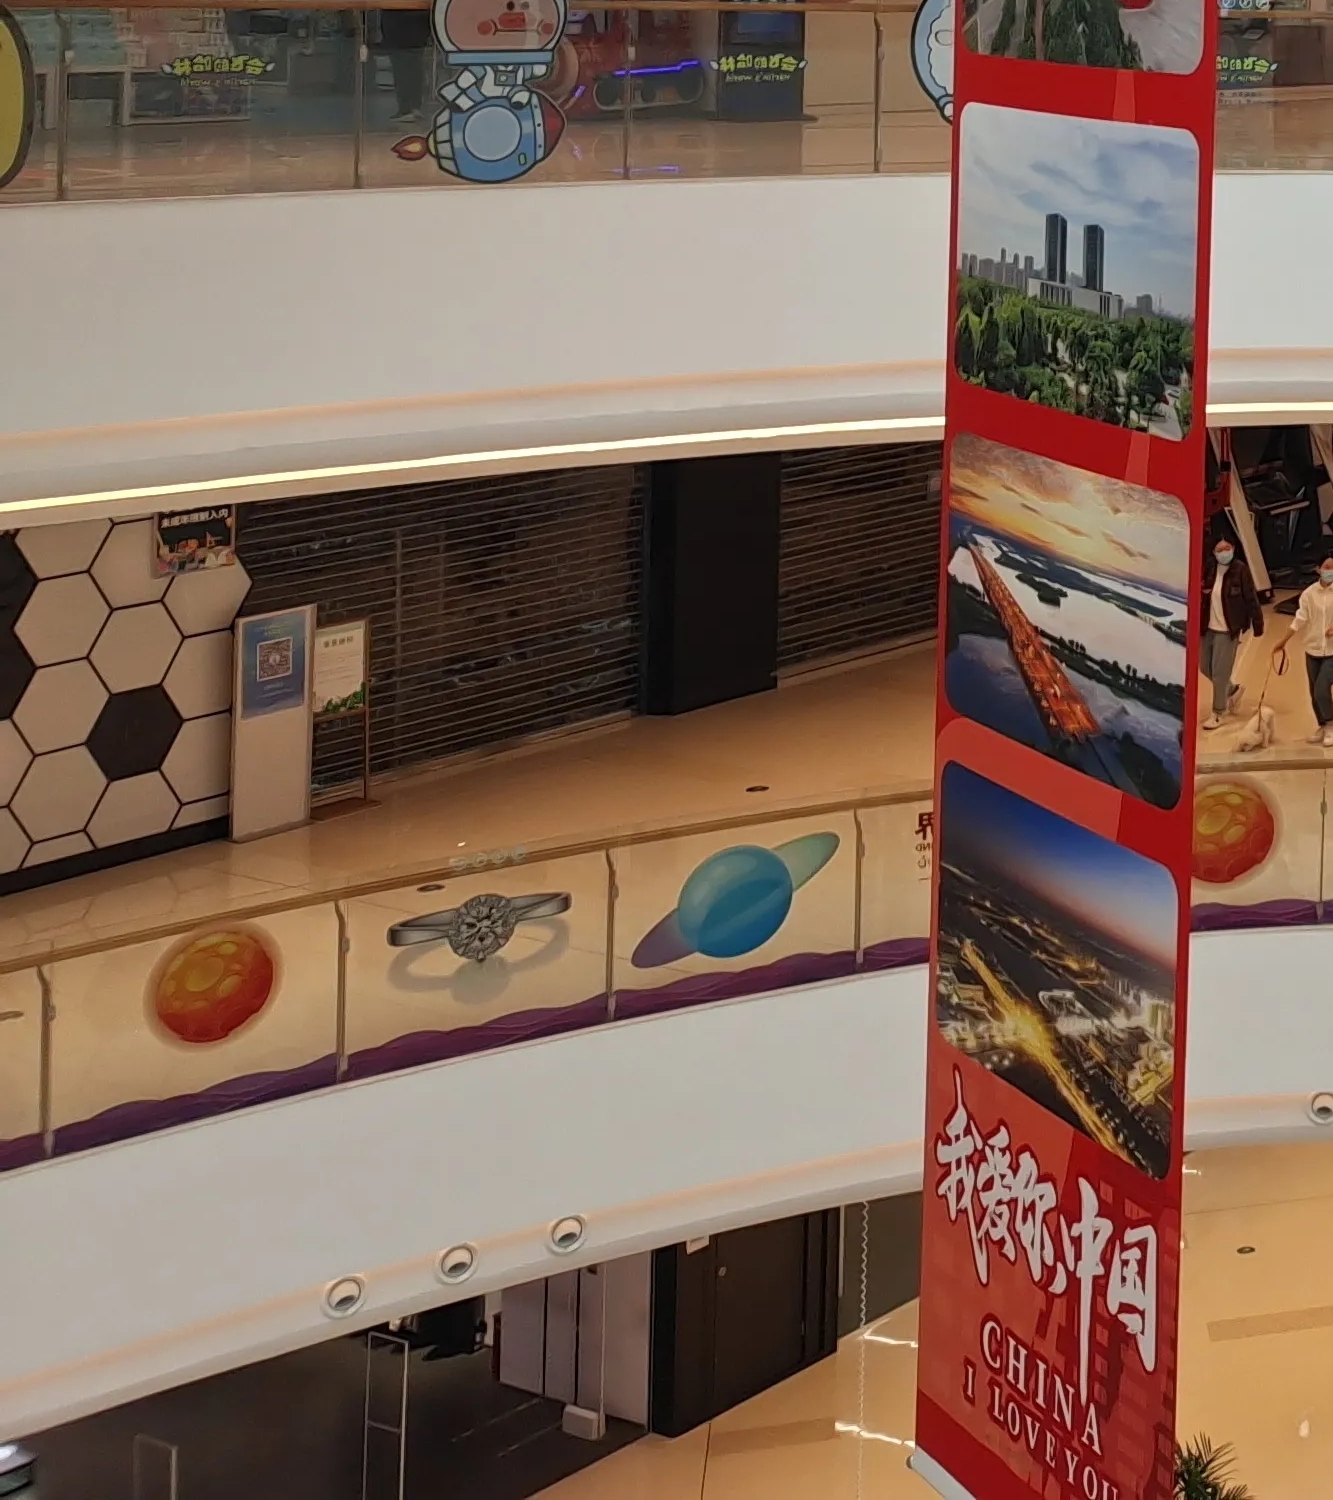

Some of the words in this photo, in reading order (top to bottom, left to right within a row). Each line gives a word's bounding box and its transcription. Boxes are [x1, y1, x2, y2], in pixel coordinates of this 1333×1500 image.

[964, 1363, 975, 1399] I
[992, 1384, 1057, 1470] LOVE
[1065, 1448, 1120, 1500] YOU
[980, 1318, 1104, 1456] CHINA
